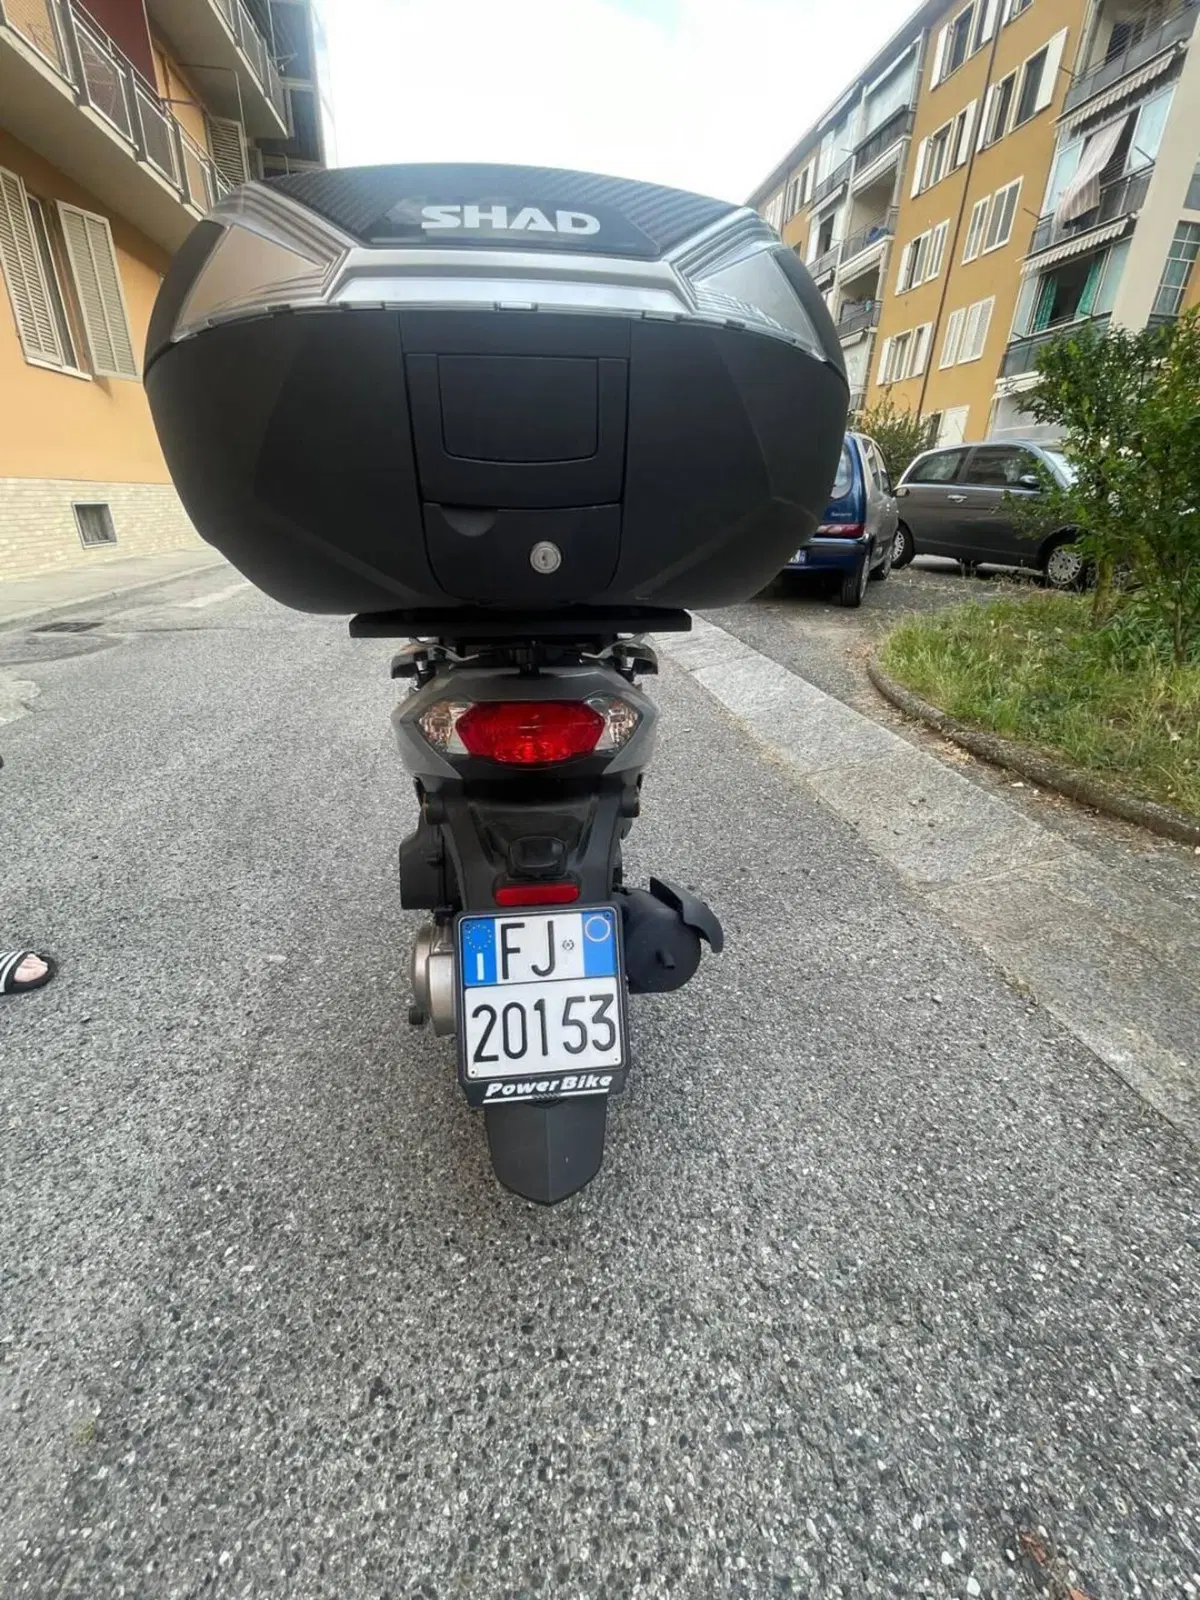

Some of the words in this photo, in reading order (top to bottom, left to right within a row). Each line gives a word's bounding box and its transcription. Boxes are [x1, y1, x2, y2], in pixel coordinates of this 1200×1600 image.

[421, 204, 600, 235] SHAD
[476, 952, 485, 981] I
[500, 920, 556, 979] FJ
[471, 994, 617, 1063] 20153
